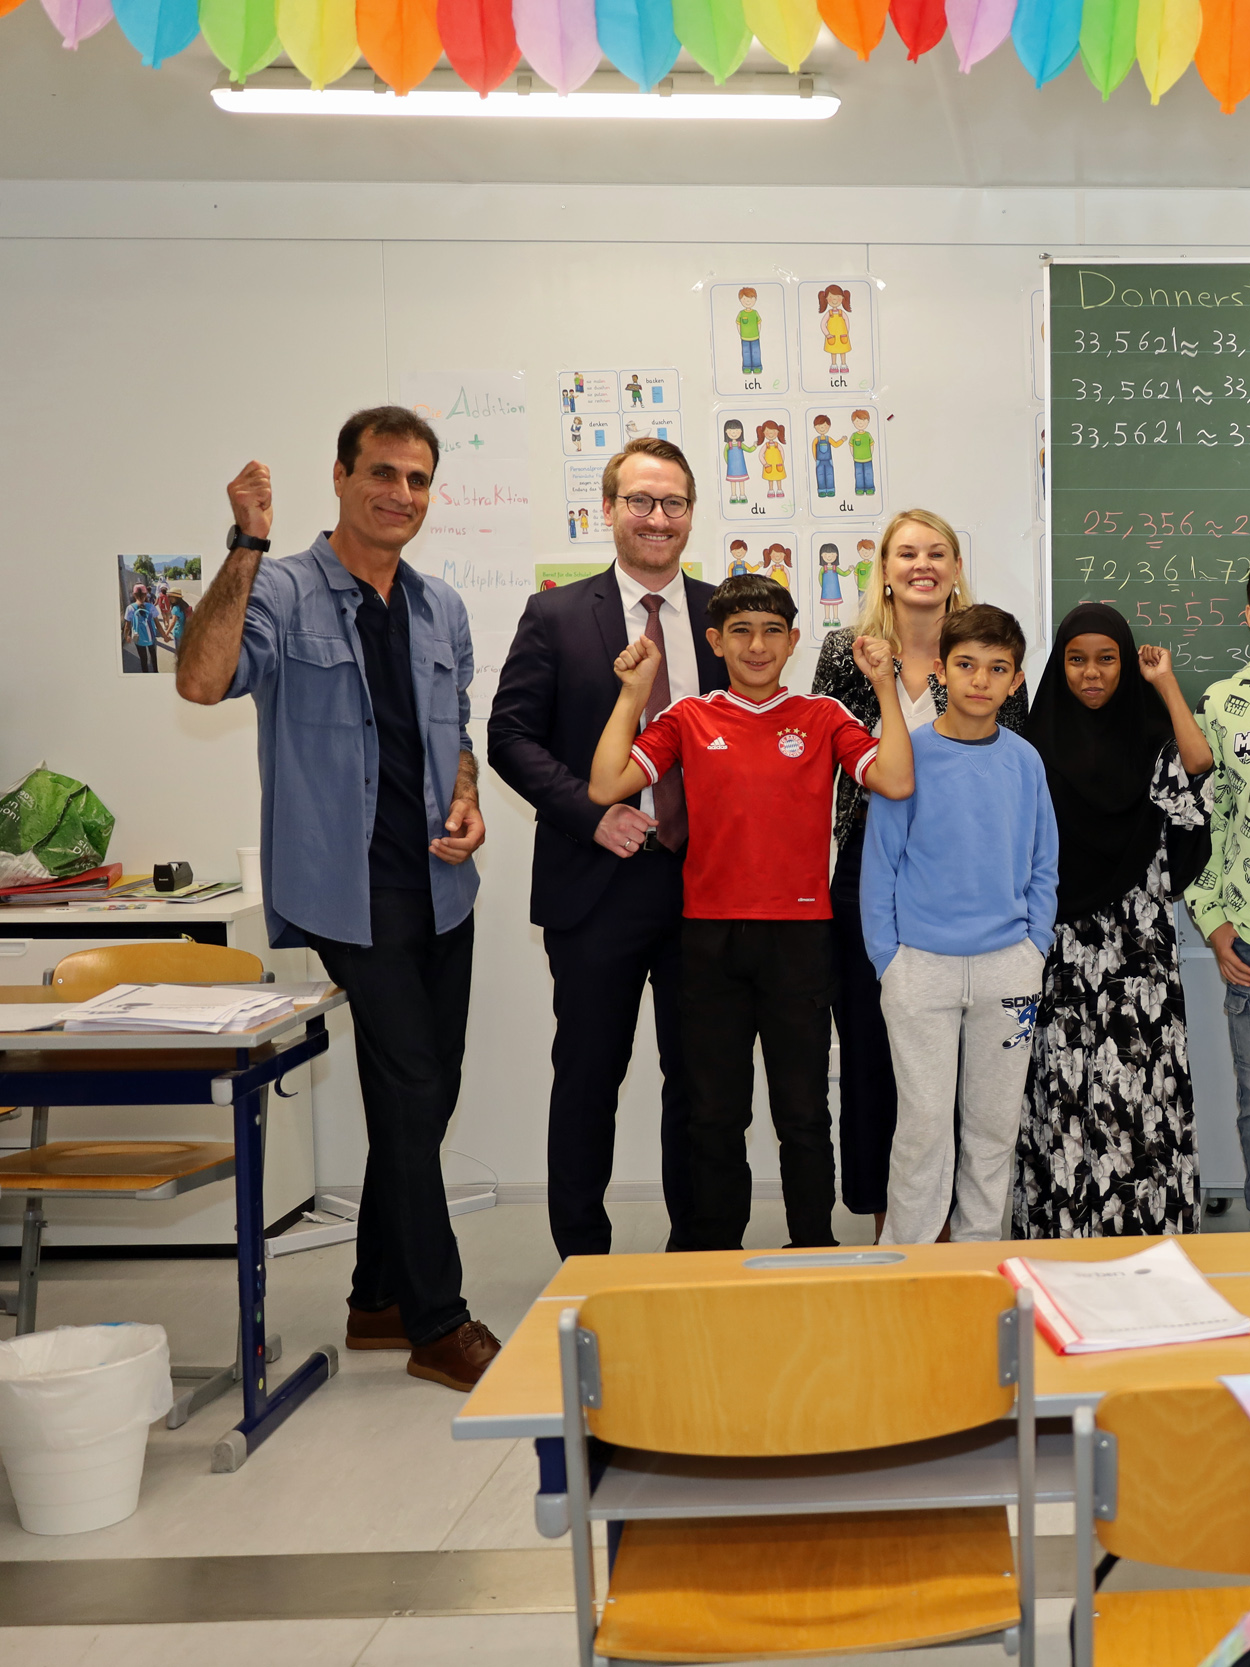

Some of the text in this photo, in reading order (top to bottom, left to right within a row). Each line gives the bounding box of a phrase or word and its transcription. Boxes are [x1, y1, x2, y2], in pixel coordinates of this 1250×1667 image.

[744, 378, 762, 390] ich
[830, 375, 848, 388] ich
[1071, 378, 1184, 405] 33,5621
[445, 386, 526, 420] Addition
[1071, 420, 1184, 449] 33,5621
[751, 502, 766, 515] du
[839, 499, 854, 512] du
[1083, 510, 1195, 540] 25,356
[1074, 554, 1197, 591] 72,361
